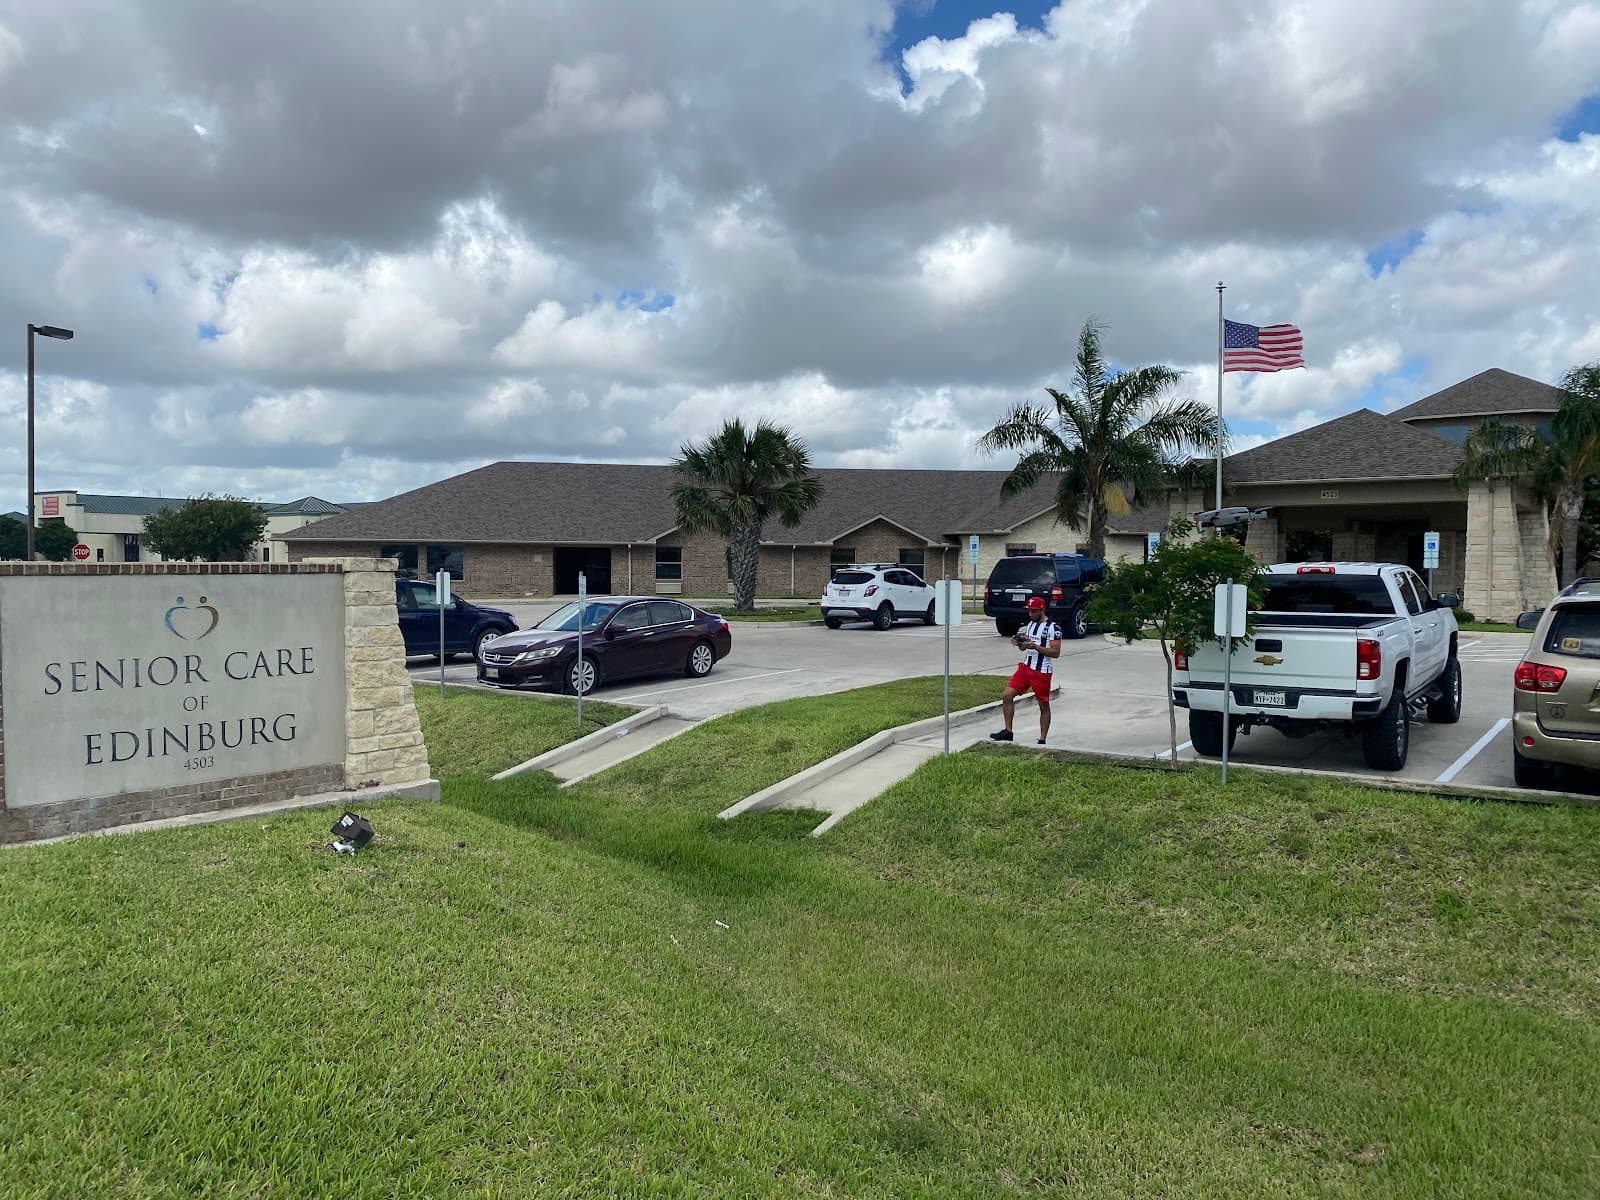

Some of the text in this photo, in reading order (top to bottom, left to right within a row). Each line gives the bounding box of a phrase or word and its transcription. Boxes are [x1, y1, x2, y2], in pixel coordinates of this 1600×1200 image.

[44, 647, 315, 695] SENIOR CARE
[182, 695, 209, 711] OF
[84, 713, 297, 765] EDINBURG
[183, 755, 215, 771] 4503
